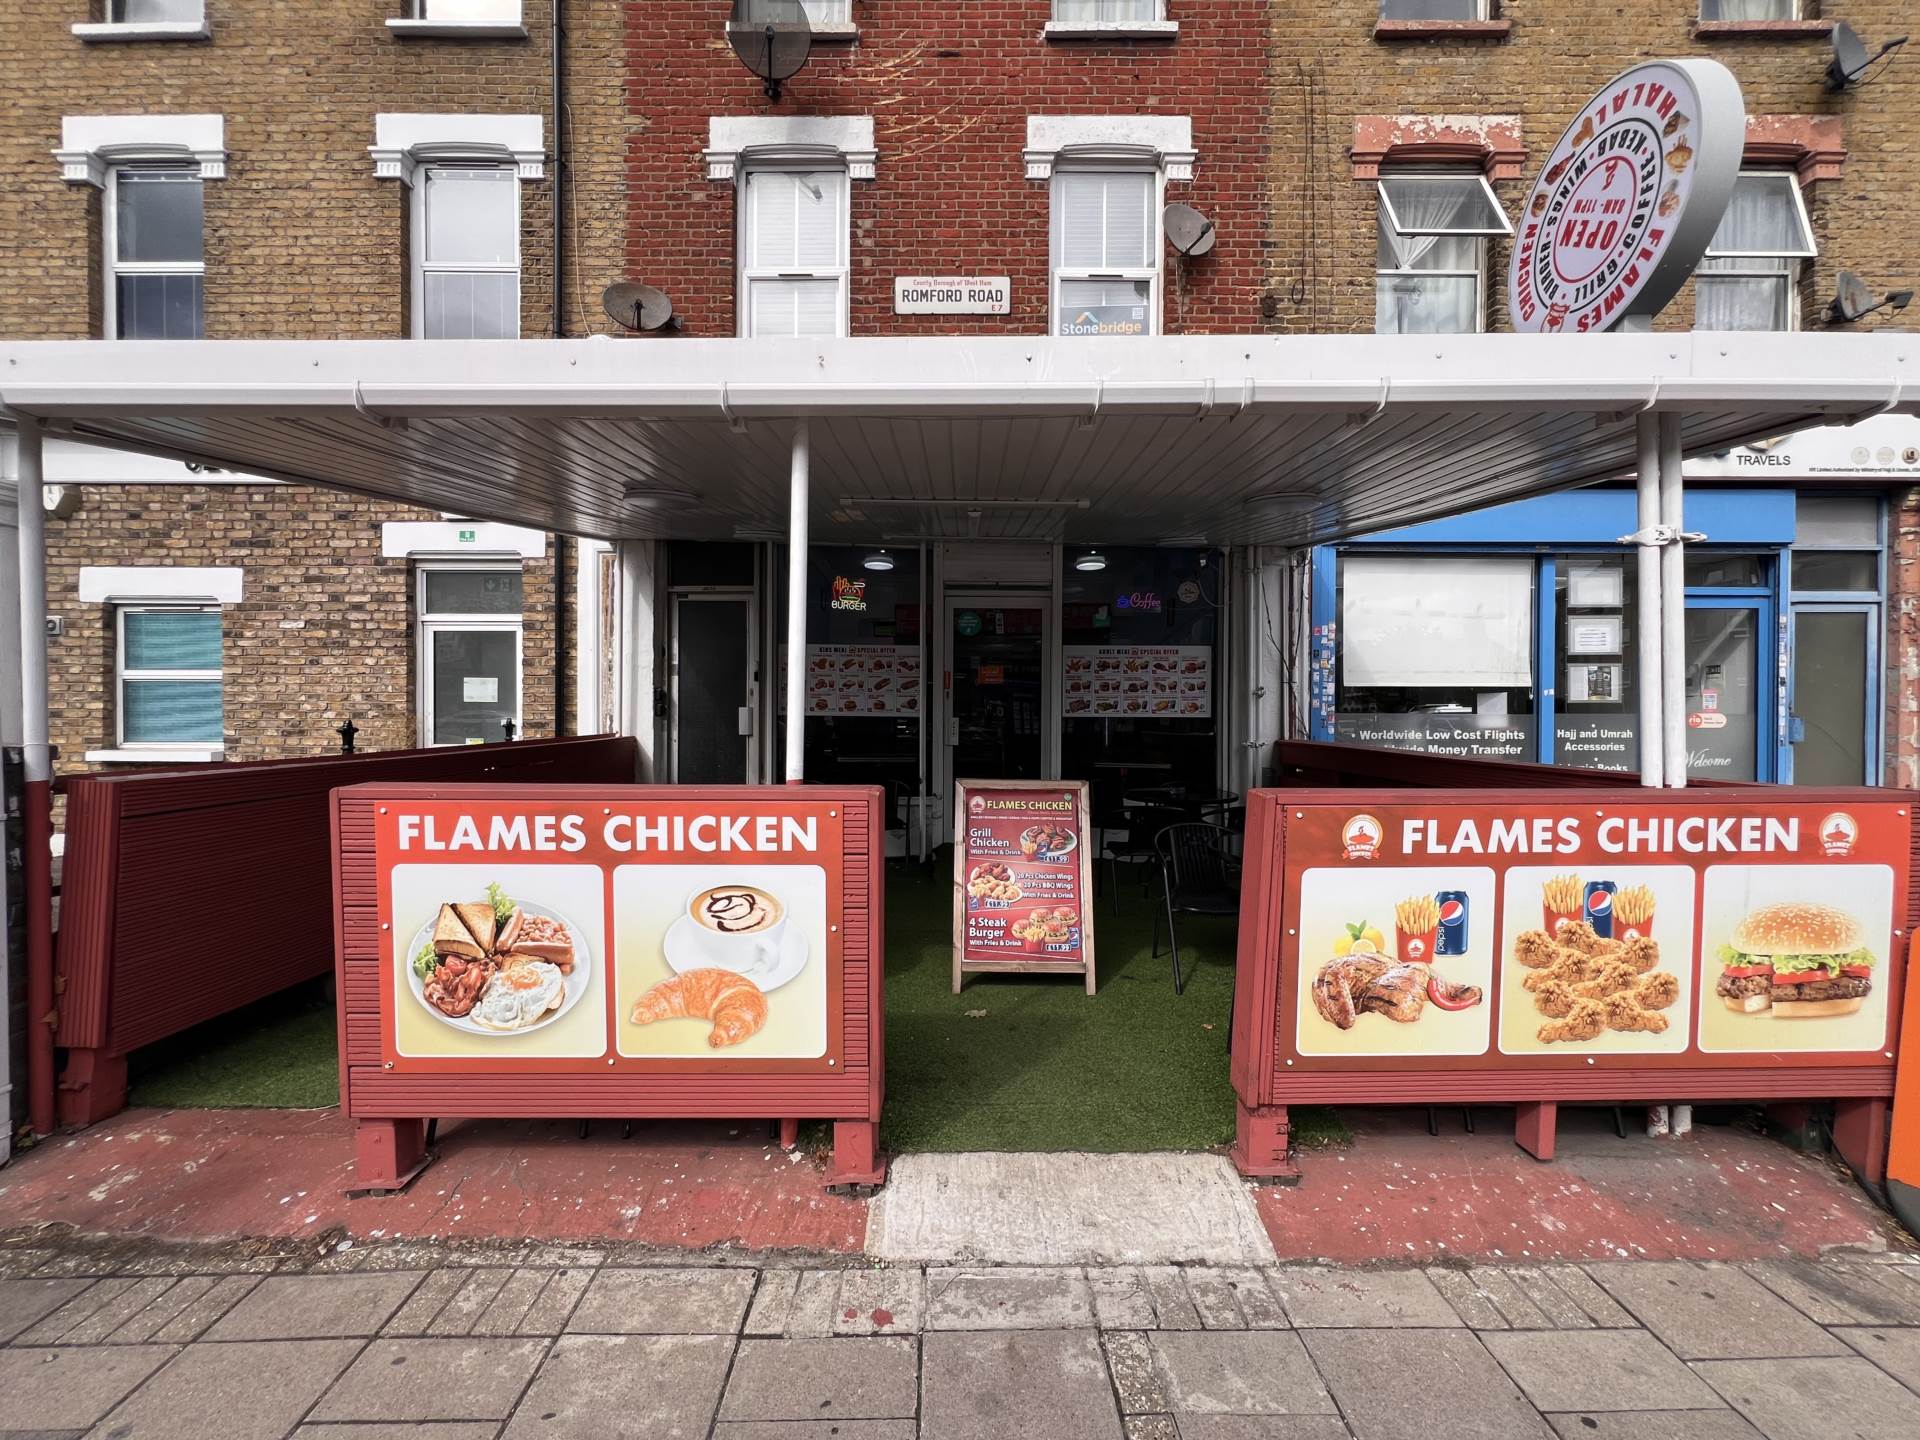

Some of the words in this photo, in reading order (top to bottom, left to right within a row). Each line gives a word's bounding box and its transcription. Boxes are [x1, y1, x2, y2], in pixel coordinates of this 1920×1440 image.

[1596, 83, 1677, 125] HALAL
[1597, 128, 1648, 157] KEBAB
[1548, 157, 1588, 227] WINGS
[1573, 199, 1598, 214] 11PM
[1622, 151, 1656, 250] COFFEE
[1559, 219, 1618, 251] OPEN
[1517, 223, 1539, 322] CHICKEN
[1539, 240, 1560, 301] BURGER
[933, 279, 955, 287] Borough
[1574, 258, 1619, 304] GRILL
[1576, 229, 1665, 332] FLAMES
[902, 289, 962, 303] ROMFORD
[968, 289, 1003, 303] ROAD
[1061, 320, 1143, 335] Stonebridge
[1736, 455, 1791, 466] TRAVELS
[831, 600, 867, 611] BURGER
[1130, 592, 1161, 609] Coffee
[1359, 729, 1422, 740] Worldwide
[1426, 729, 1449, 740] Low
[1453, 729, 1481, 740] Cost
[1484, 729, 1525, 742] Flights
[1557, 729, 1577, 740] Hajj
[1579, 729, 1598, 738] and
[1600, 729, 1633, 739] Umrah
[1428, 744, 1467, 756] Money
[1471, 744, 1523, 755] Transfer
[1564, 742, 1625, 751] Accessories
[987, 800, 1027, 810] FLAMES
[1028, 801, 1072, 811] CHICKEN
[398, 815, 587, 851] FLAMES
[603, 815, 818, 852] CHICKEN
[970, 828, 991, 837] Grill
[1402, 817, 1581, 854] FLAMES
[1597, 817, 1800, 854] CHICKEN
[970, 837, 1010, 847] Chicken
[1057, 873, 1074, 881] Wings
[1056, 882, 1074, 890] Wings
[969, 918, 976, 926] 4
[978, 918, 1007, 927] Steak
[969, 928, 1005, 939] Burger
[1437, 926, 1446, 952] pepsi
